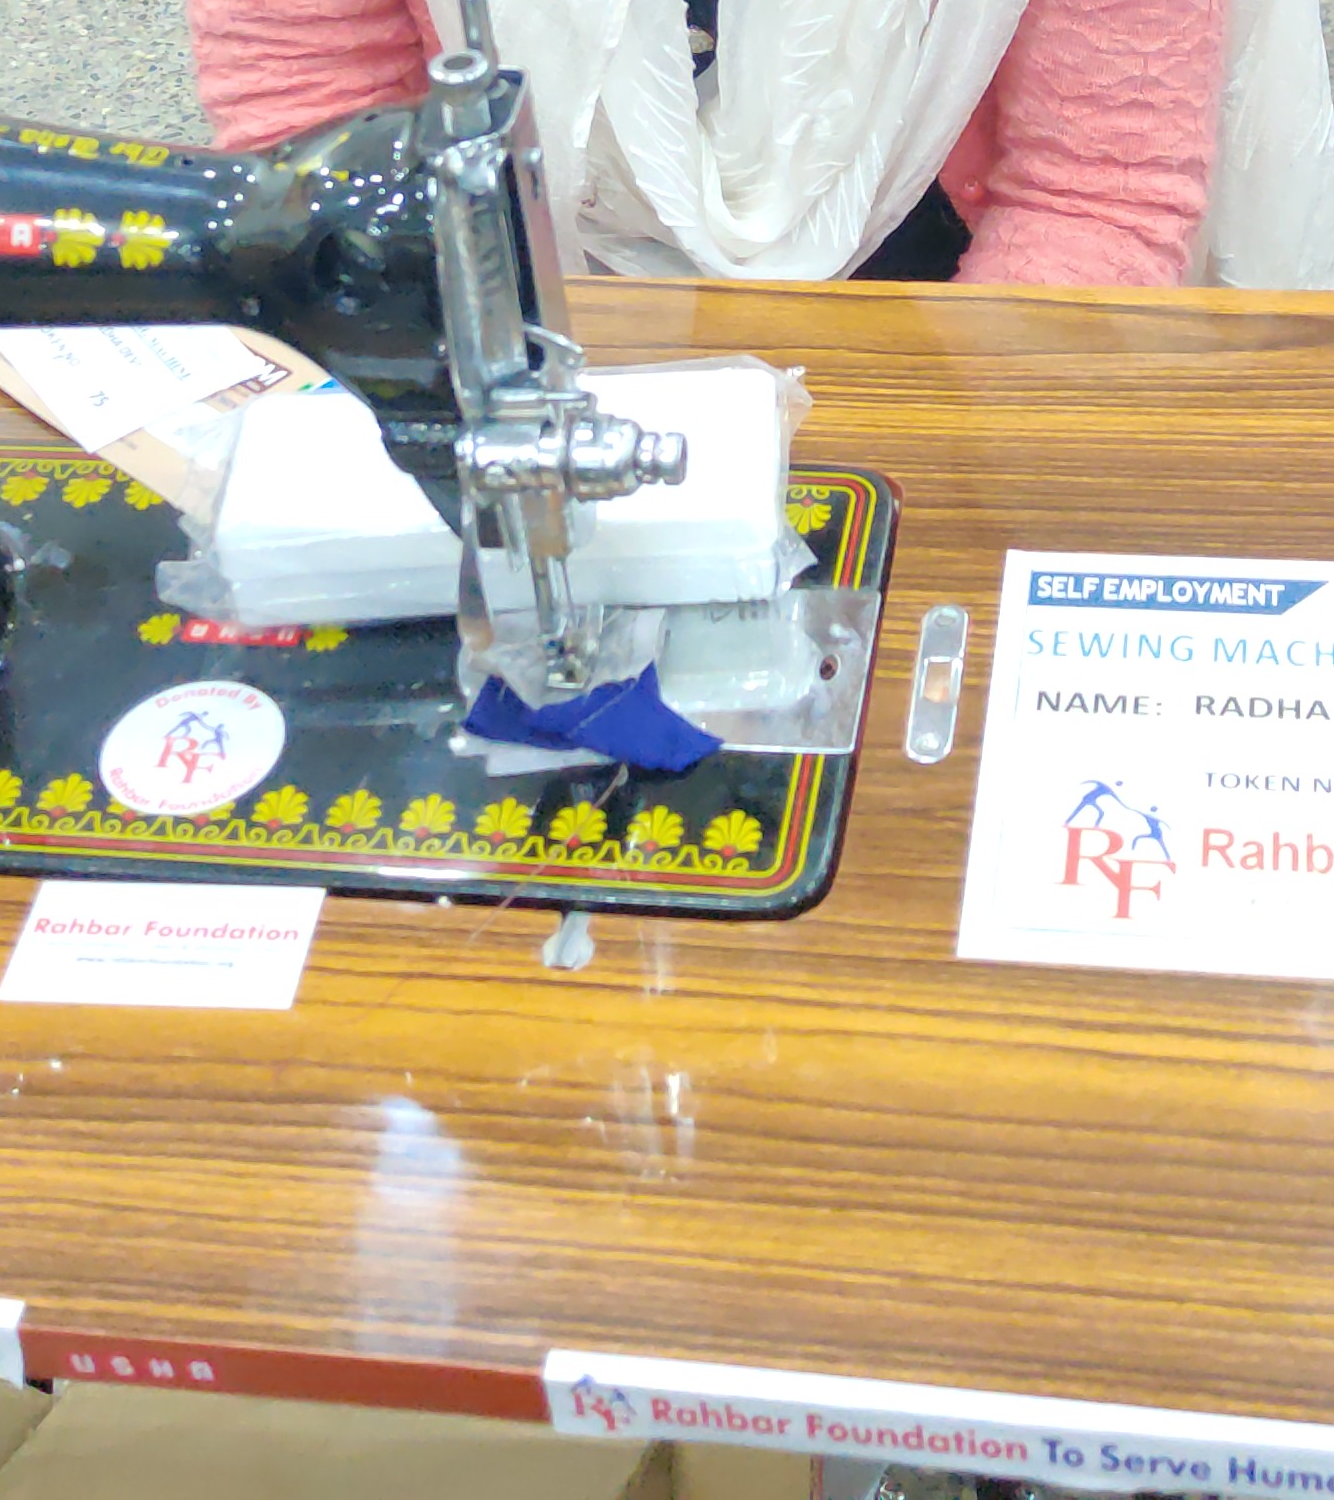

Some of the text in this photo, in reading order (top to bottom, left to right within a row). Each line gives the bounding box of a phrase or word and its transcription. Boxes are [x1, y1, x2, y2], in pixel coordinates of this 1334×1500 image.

[1035, 574, 1286, 608] SELF EMPLOYMENT
[1027, 628, 1195, 663] SEWING
[154, 686, 264, 711] Donated By
[1035, 690, 1163, 717] NAME:
[1194, 694, 1331, 721] RADHA
[109, 766, 151, 806] Rahbar
[1204, 771, 1301, 793] TOKEN
[1054, 825, 1178, 920] RF
[33, 917, 300, 941] Rahbar Foundation
[71, 1352, 217, 1382] USHA
[649, 1397, 792, 1437] Rahbar
[805, 1412, 1029, 1462] Foundation
[1041, 1436, 1085, 1466] To
[1098, 1443, 1213, 1481] Serve
